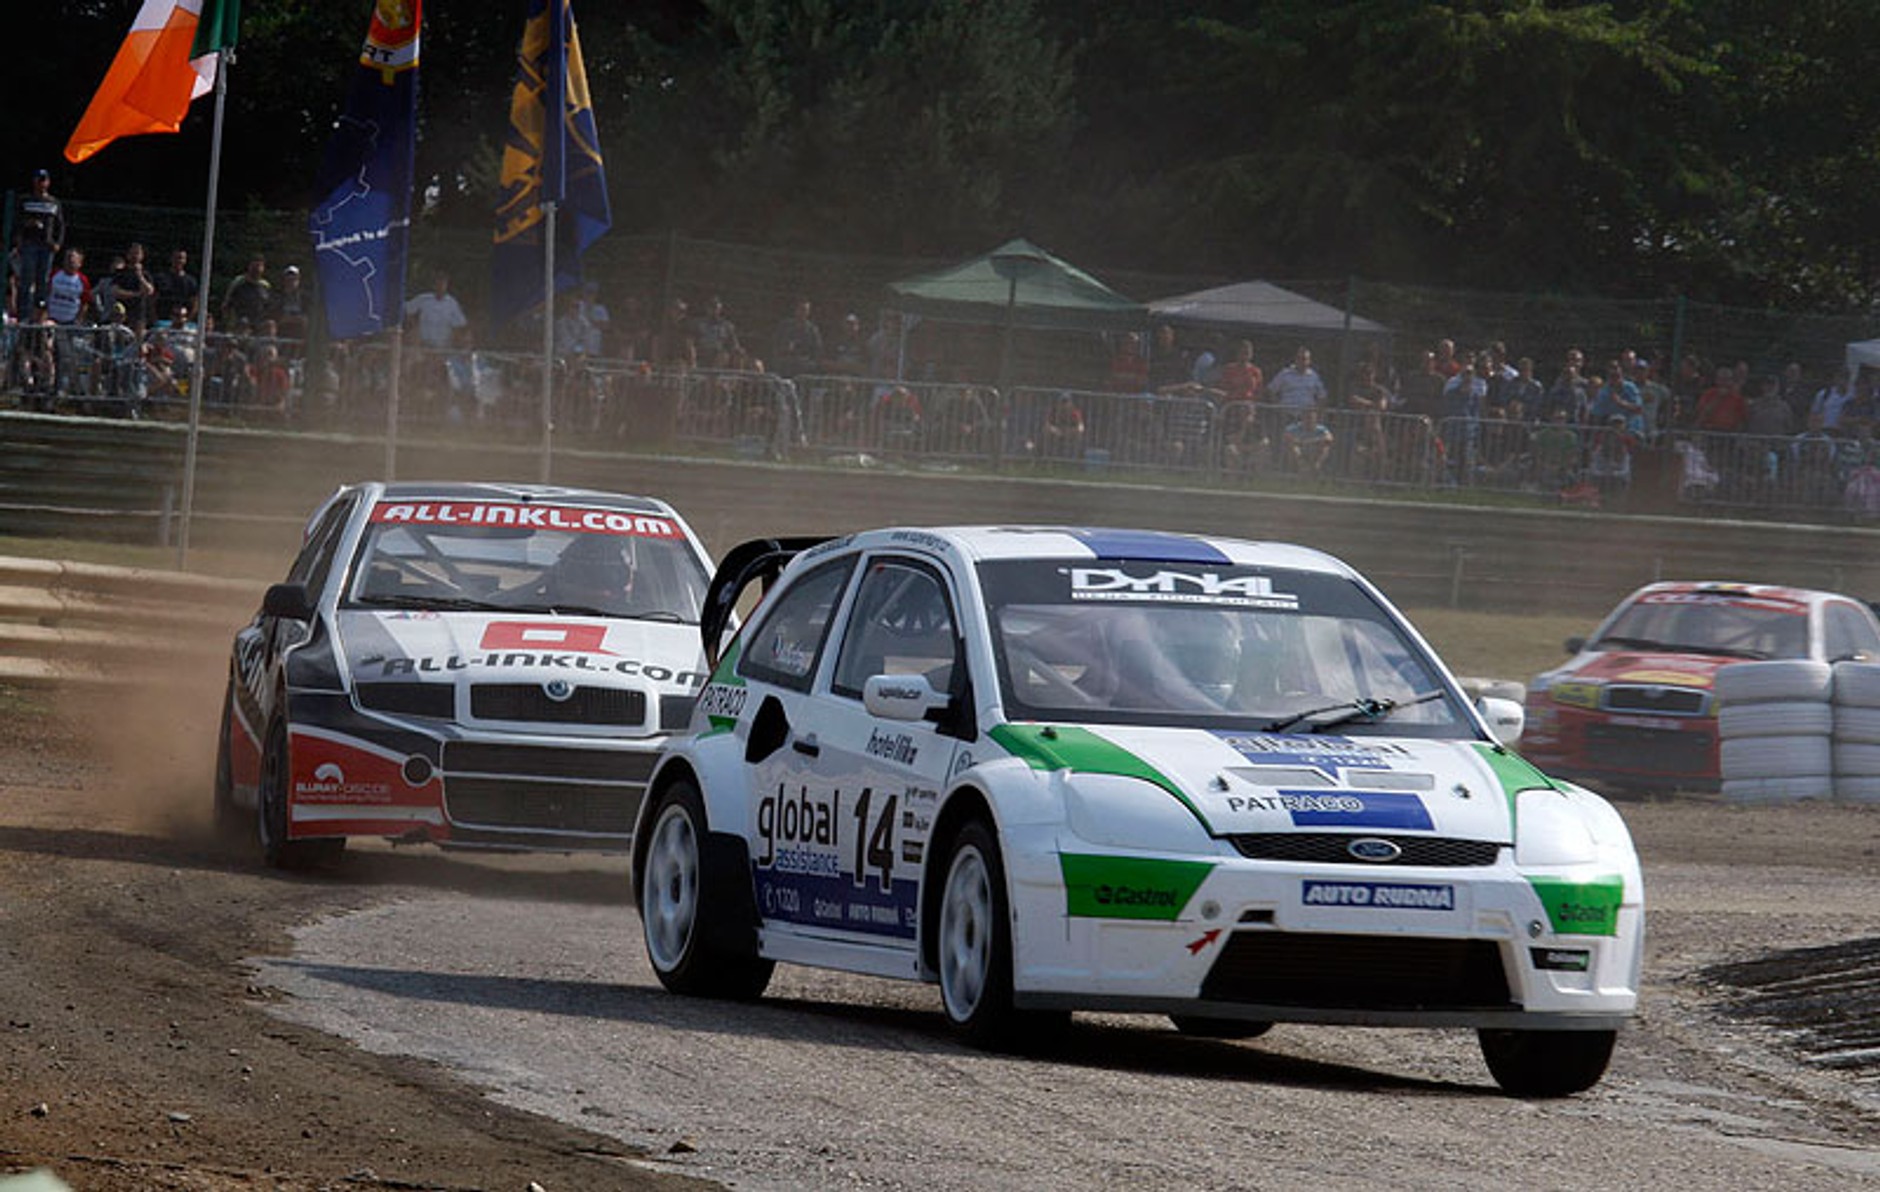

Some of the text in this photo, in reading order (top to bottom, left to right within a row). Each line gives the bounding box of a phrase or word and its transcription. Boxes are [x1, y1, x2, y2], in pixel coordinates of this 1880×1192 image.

[1228, 797, 1361, 812] PATRACO
[758, 782, 840, 866] global
[853, 787, 899, 891] 14
[776, 844, 840, 878] assistance
[1114, 885, 1177, 906] Castrol
[1306, 884, 1371, 904] AUTO
